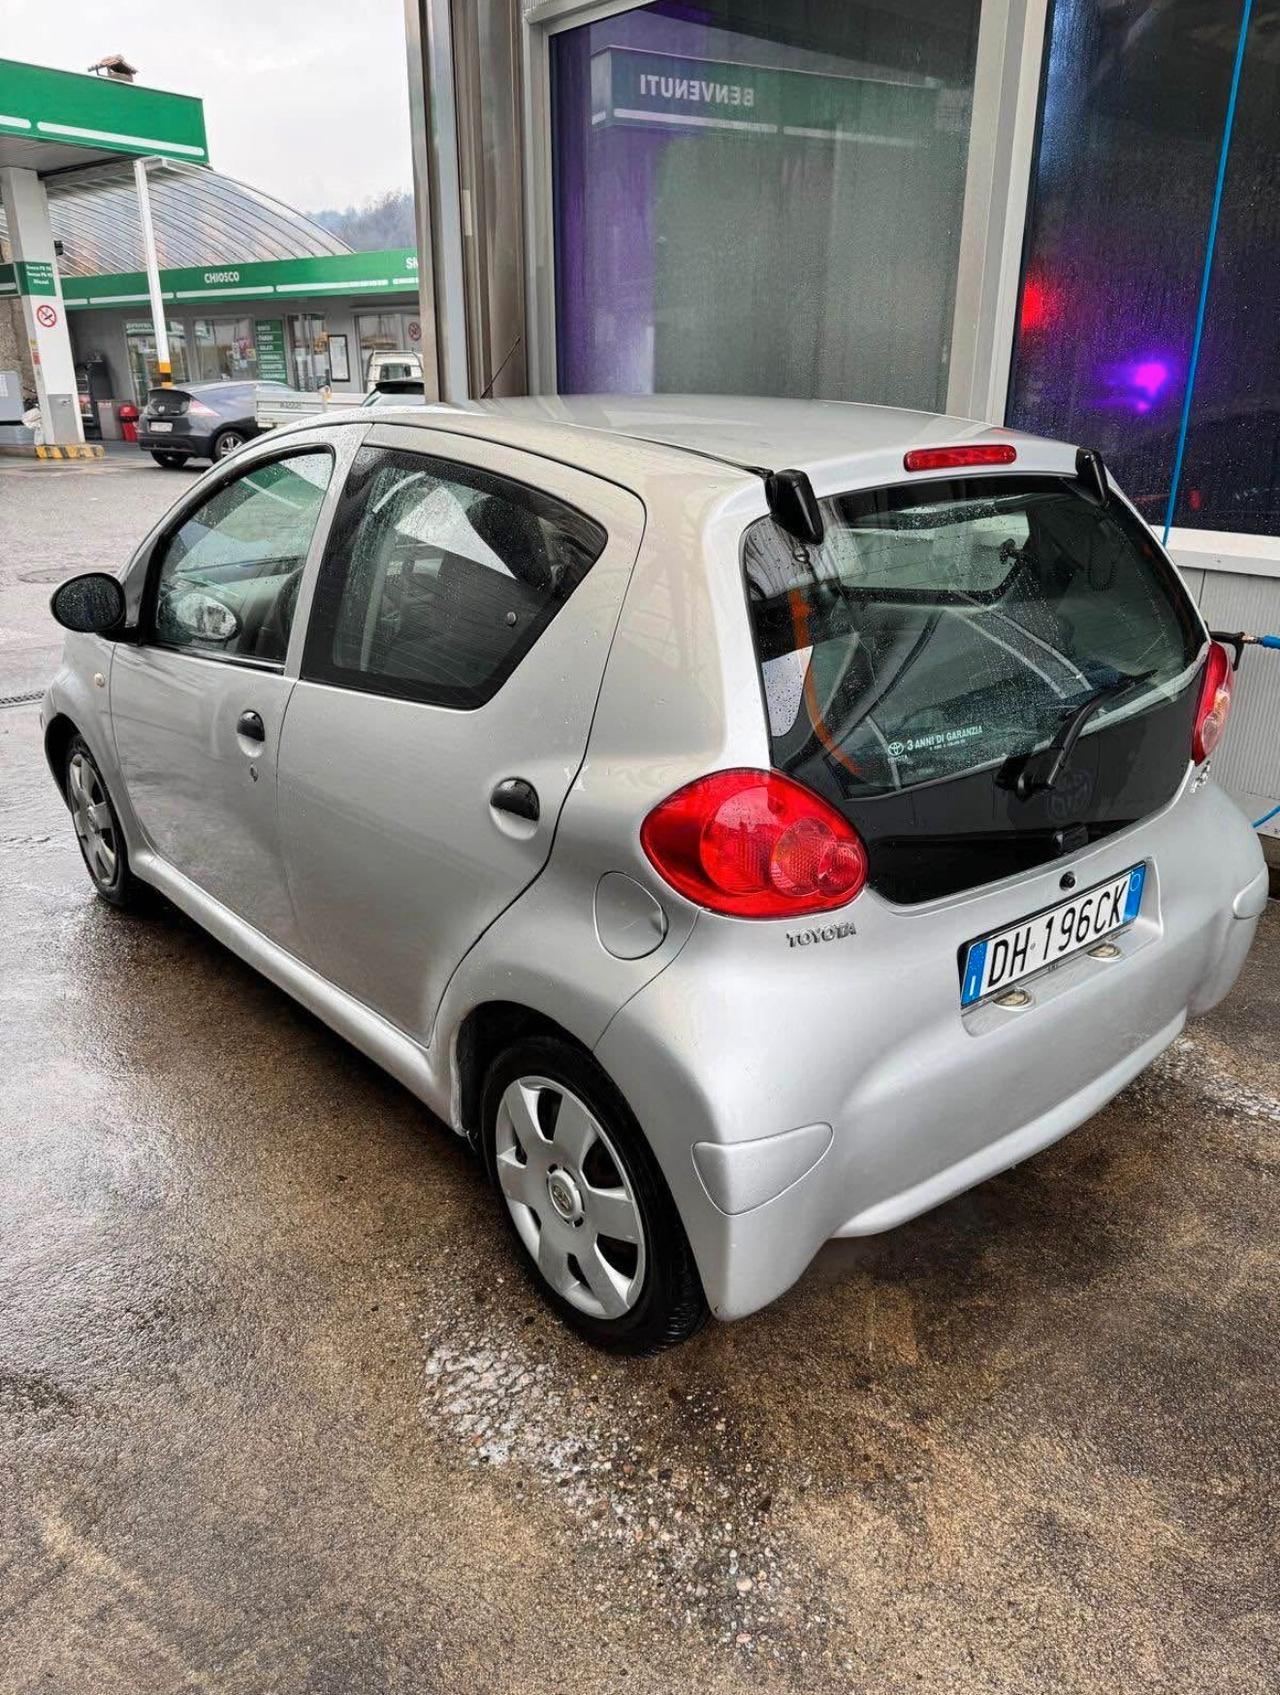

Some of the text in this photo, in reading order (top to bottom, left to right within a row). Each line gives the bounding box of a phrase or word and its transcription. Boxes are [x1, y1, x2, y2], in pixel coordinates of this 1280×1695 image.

[204, 271, 240, 284] CHIOSCO
[906, 739, 914, 751] 3
[915, 735, 935, 749] ANNI
[936, 733, 945, 744] DI
[946, 725, 983, 742] GARANZIA
[786, 922, 857, 948] TOYOTA
[987, 926, 1032, 988] DH
[1042, 880, 1128, 961] 196CK
